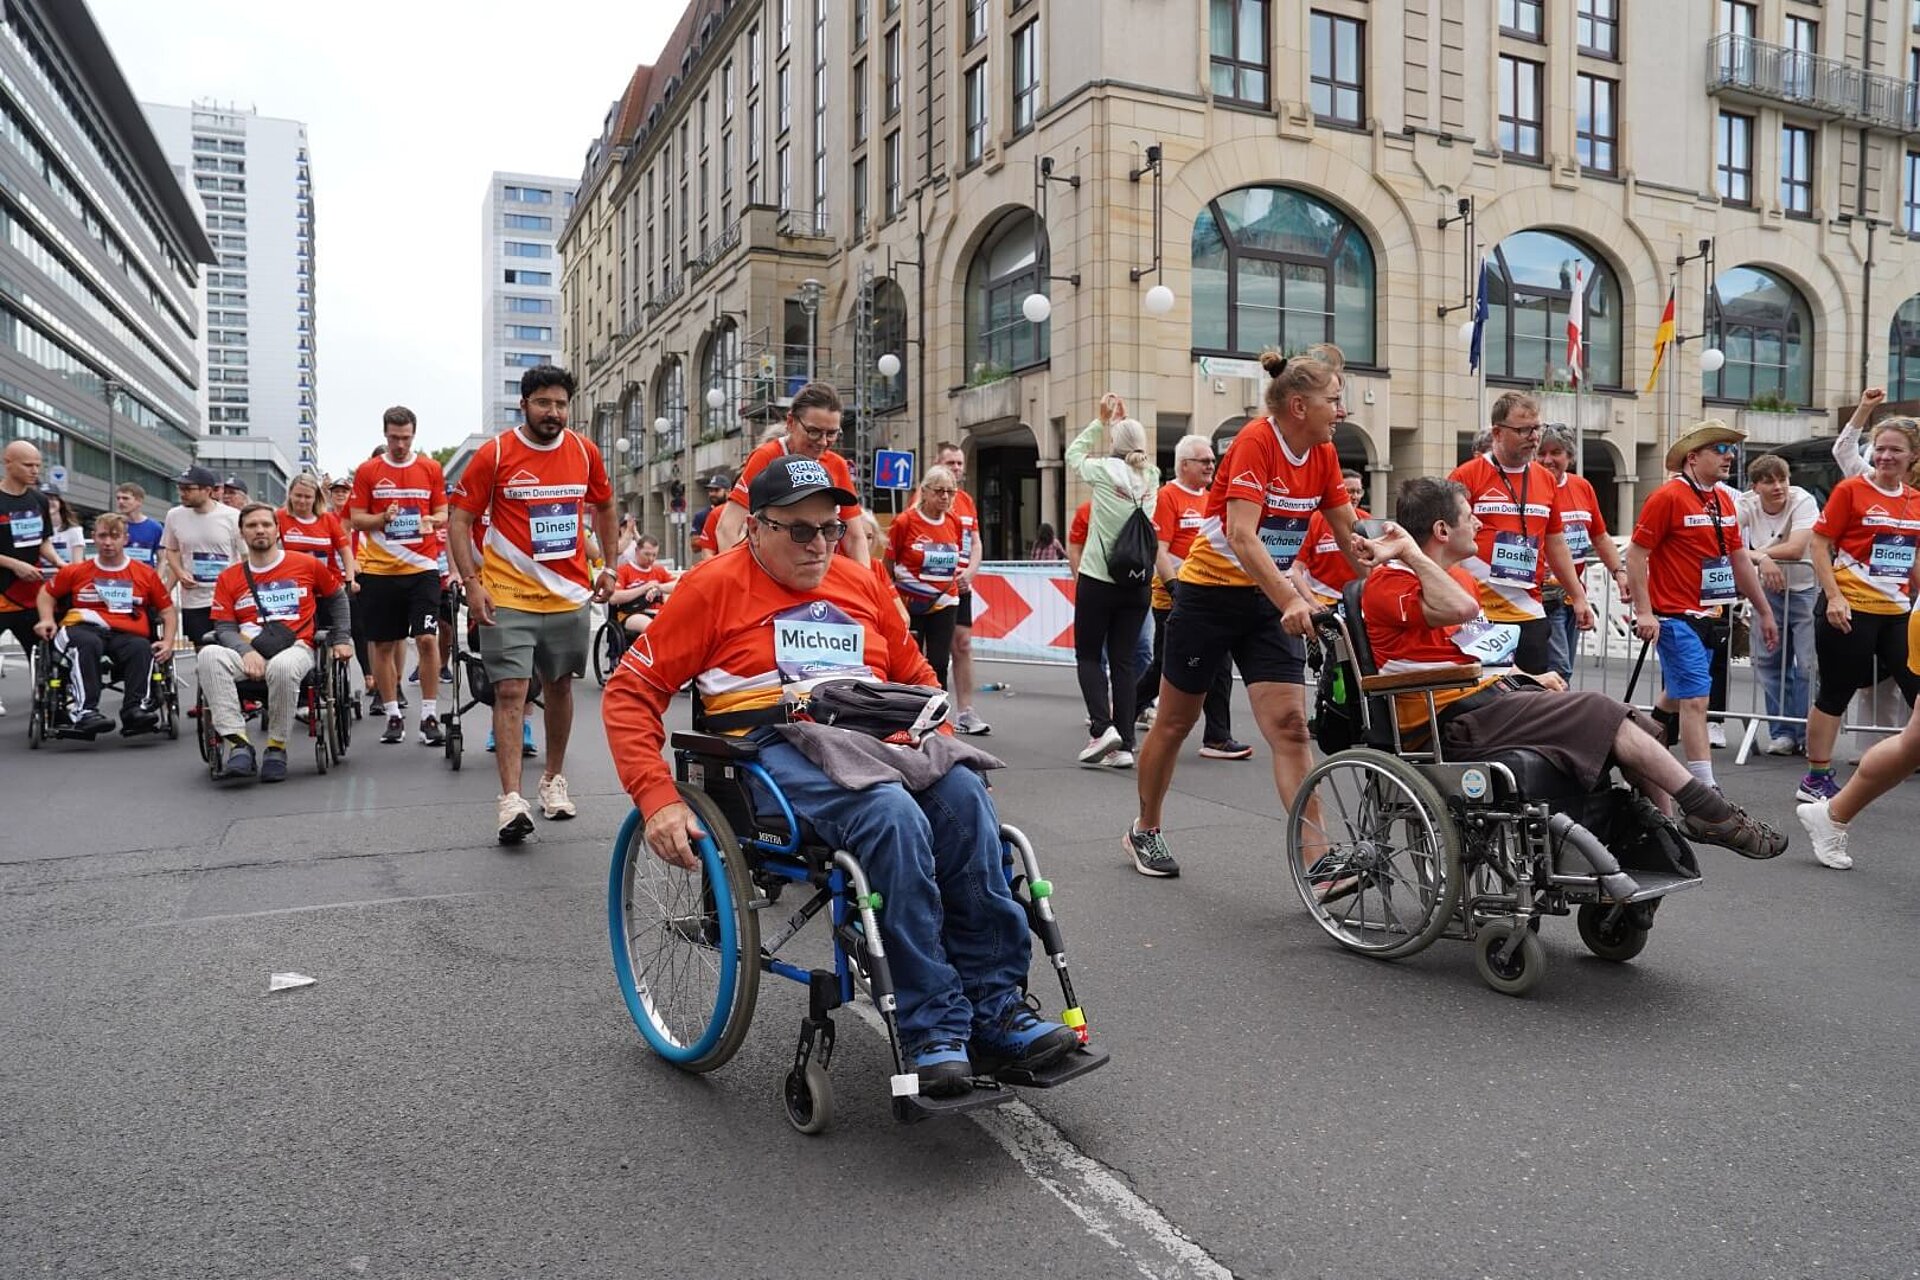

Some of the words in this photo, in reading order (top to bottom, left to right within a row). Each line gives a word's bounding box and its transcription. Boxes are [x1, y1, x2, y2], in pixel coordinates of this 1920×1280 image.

[508, 490, 531, 498] Team
[535, 520, 576, 534] Dinesh
[1875, 548, 1912, 561] Bianca
[1709, 571, 1734, 582] Söre
[781, 629, 858, 653] Michael
